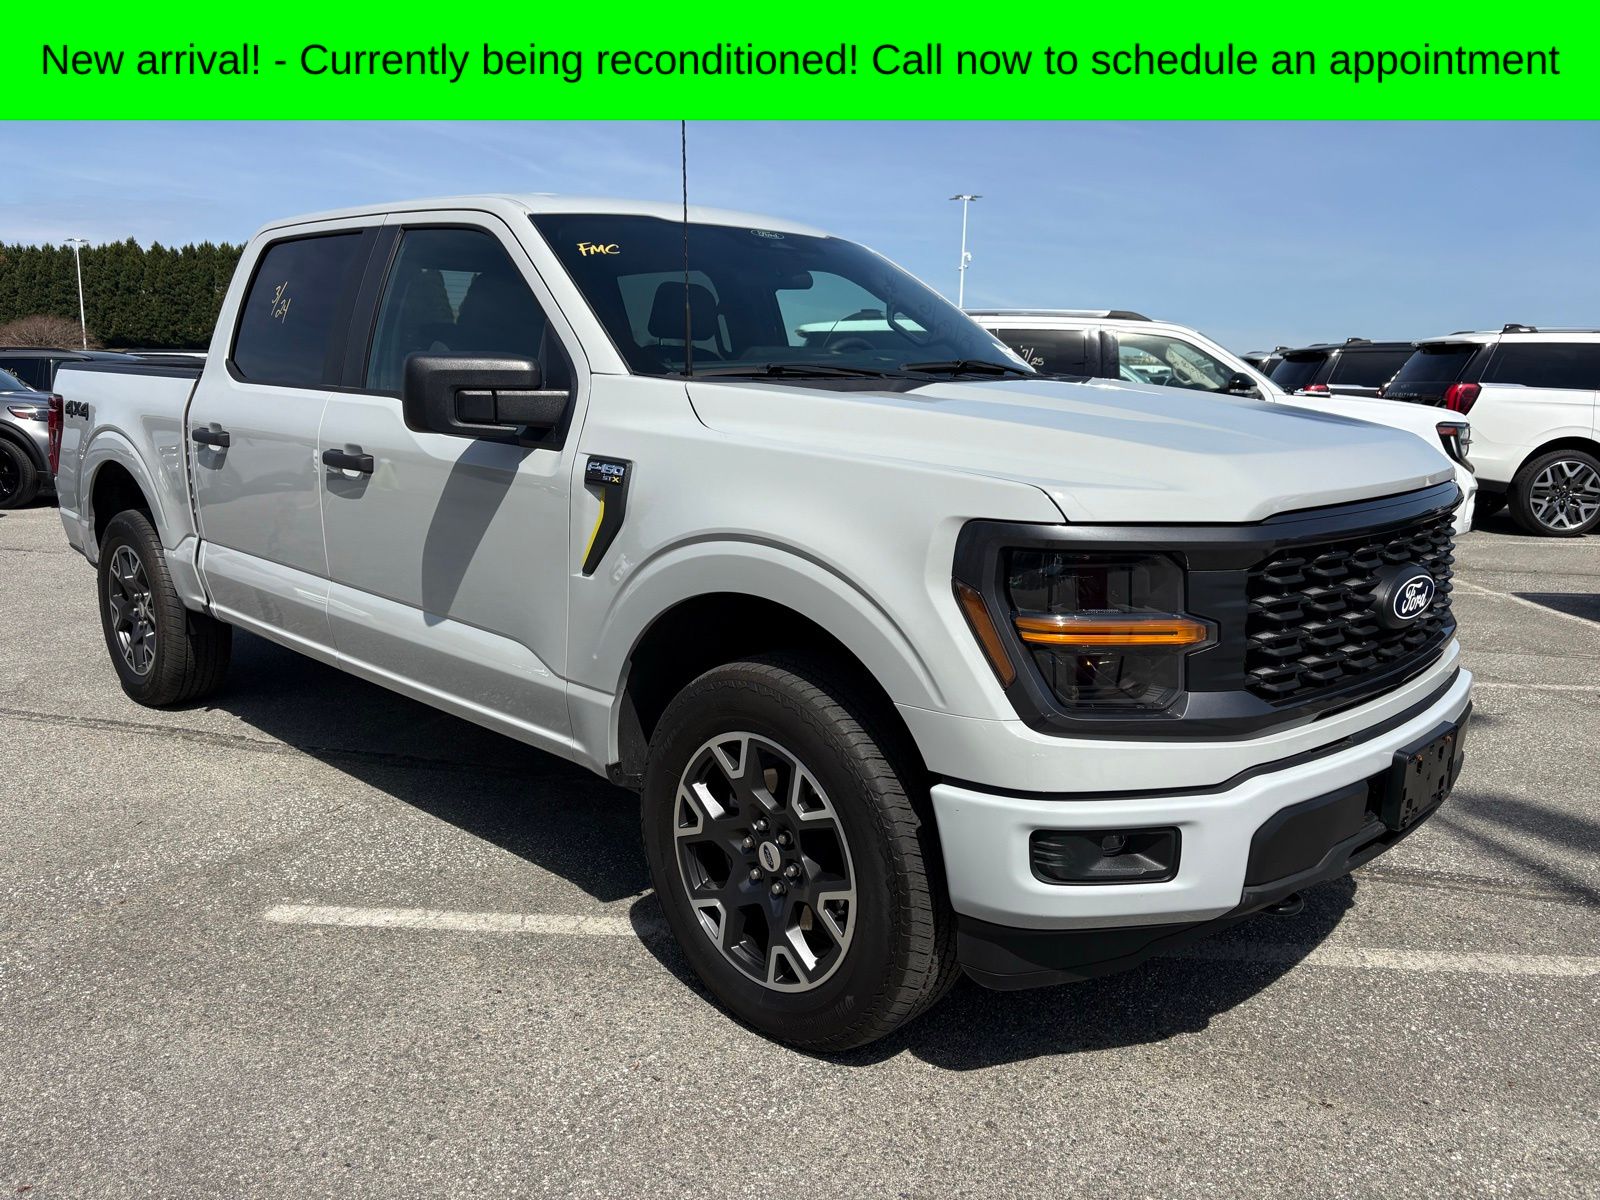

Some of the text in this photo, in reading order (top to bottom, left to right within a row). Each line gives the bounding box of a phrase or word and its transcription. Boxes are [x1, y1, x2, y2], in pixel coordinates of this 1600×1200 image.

[576, 241, 620, 256] FMC
[587, 461, 625, 476] F-150
[602, 474, 620, 483] STX
[1401, 581, 1429, 614] Ford
